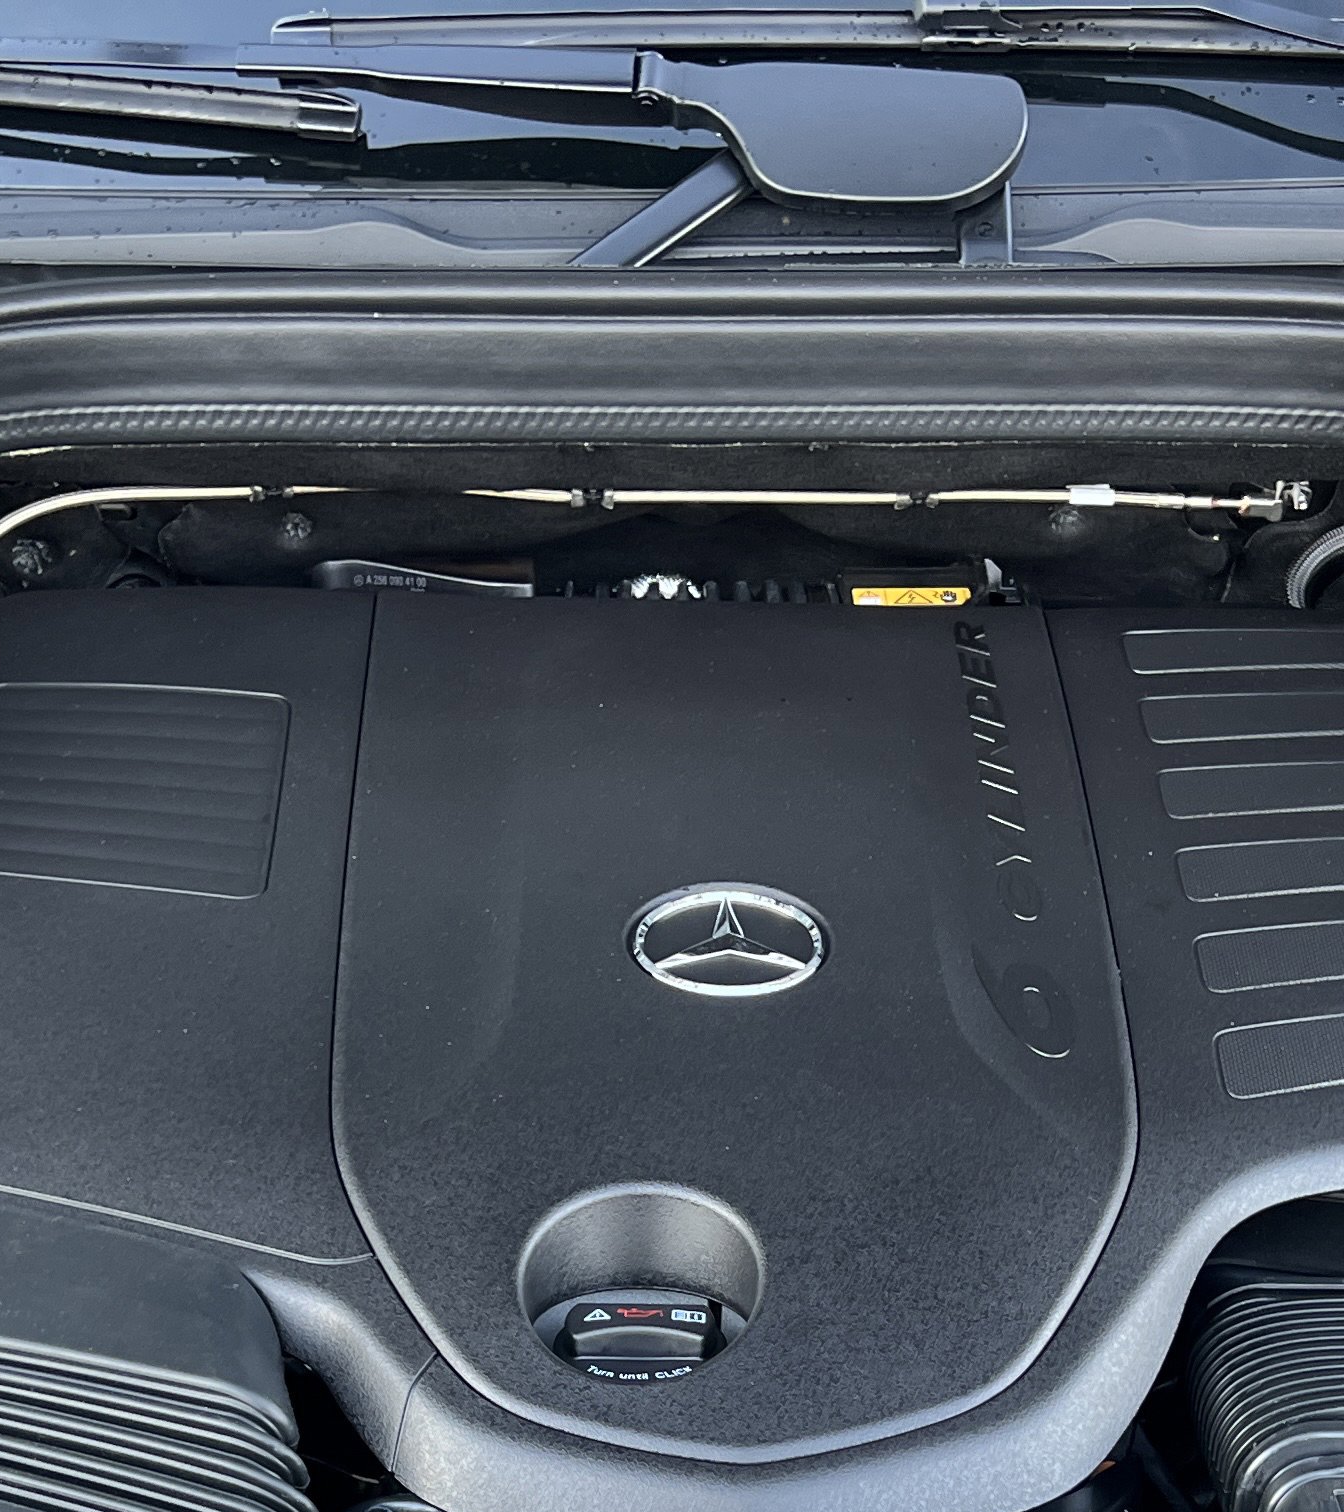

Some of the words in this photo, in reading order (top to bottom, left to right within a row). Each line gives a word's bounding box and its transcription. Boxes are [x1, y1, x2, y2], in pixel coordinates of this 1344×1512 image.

[954, 621, 1040, 921] CYLINDER
[587, 1365, 615, 1378] Turn
[619, 1372, 649, 1380] until
[655, 1365, 693, 1379] CLICK
